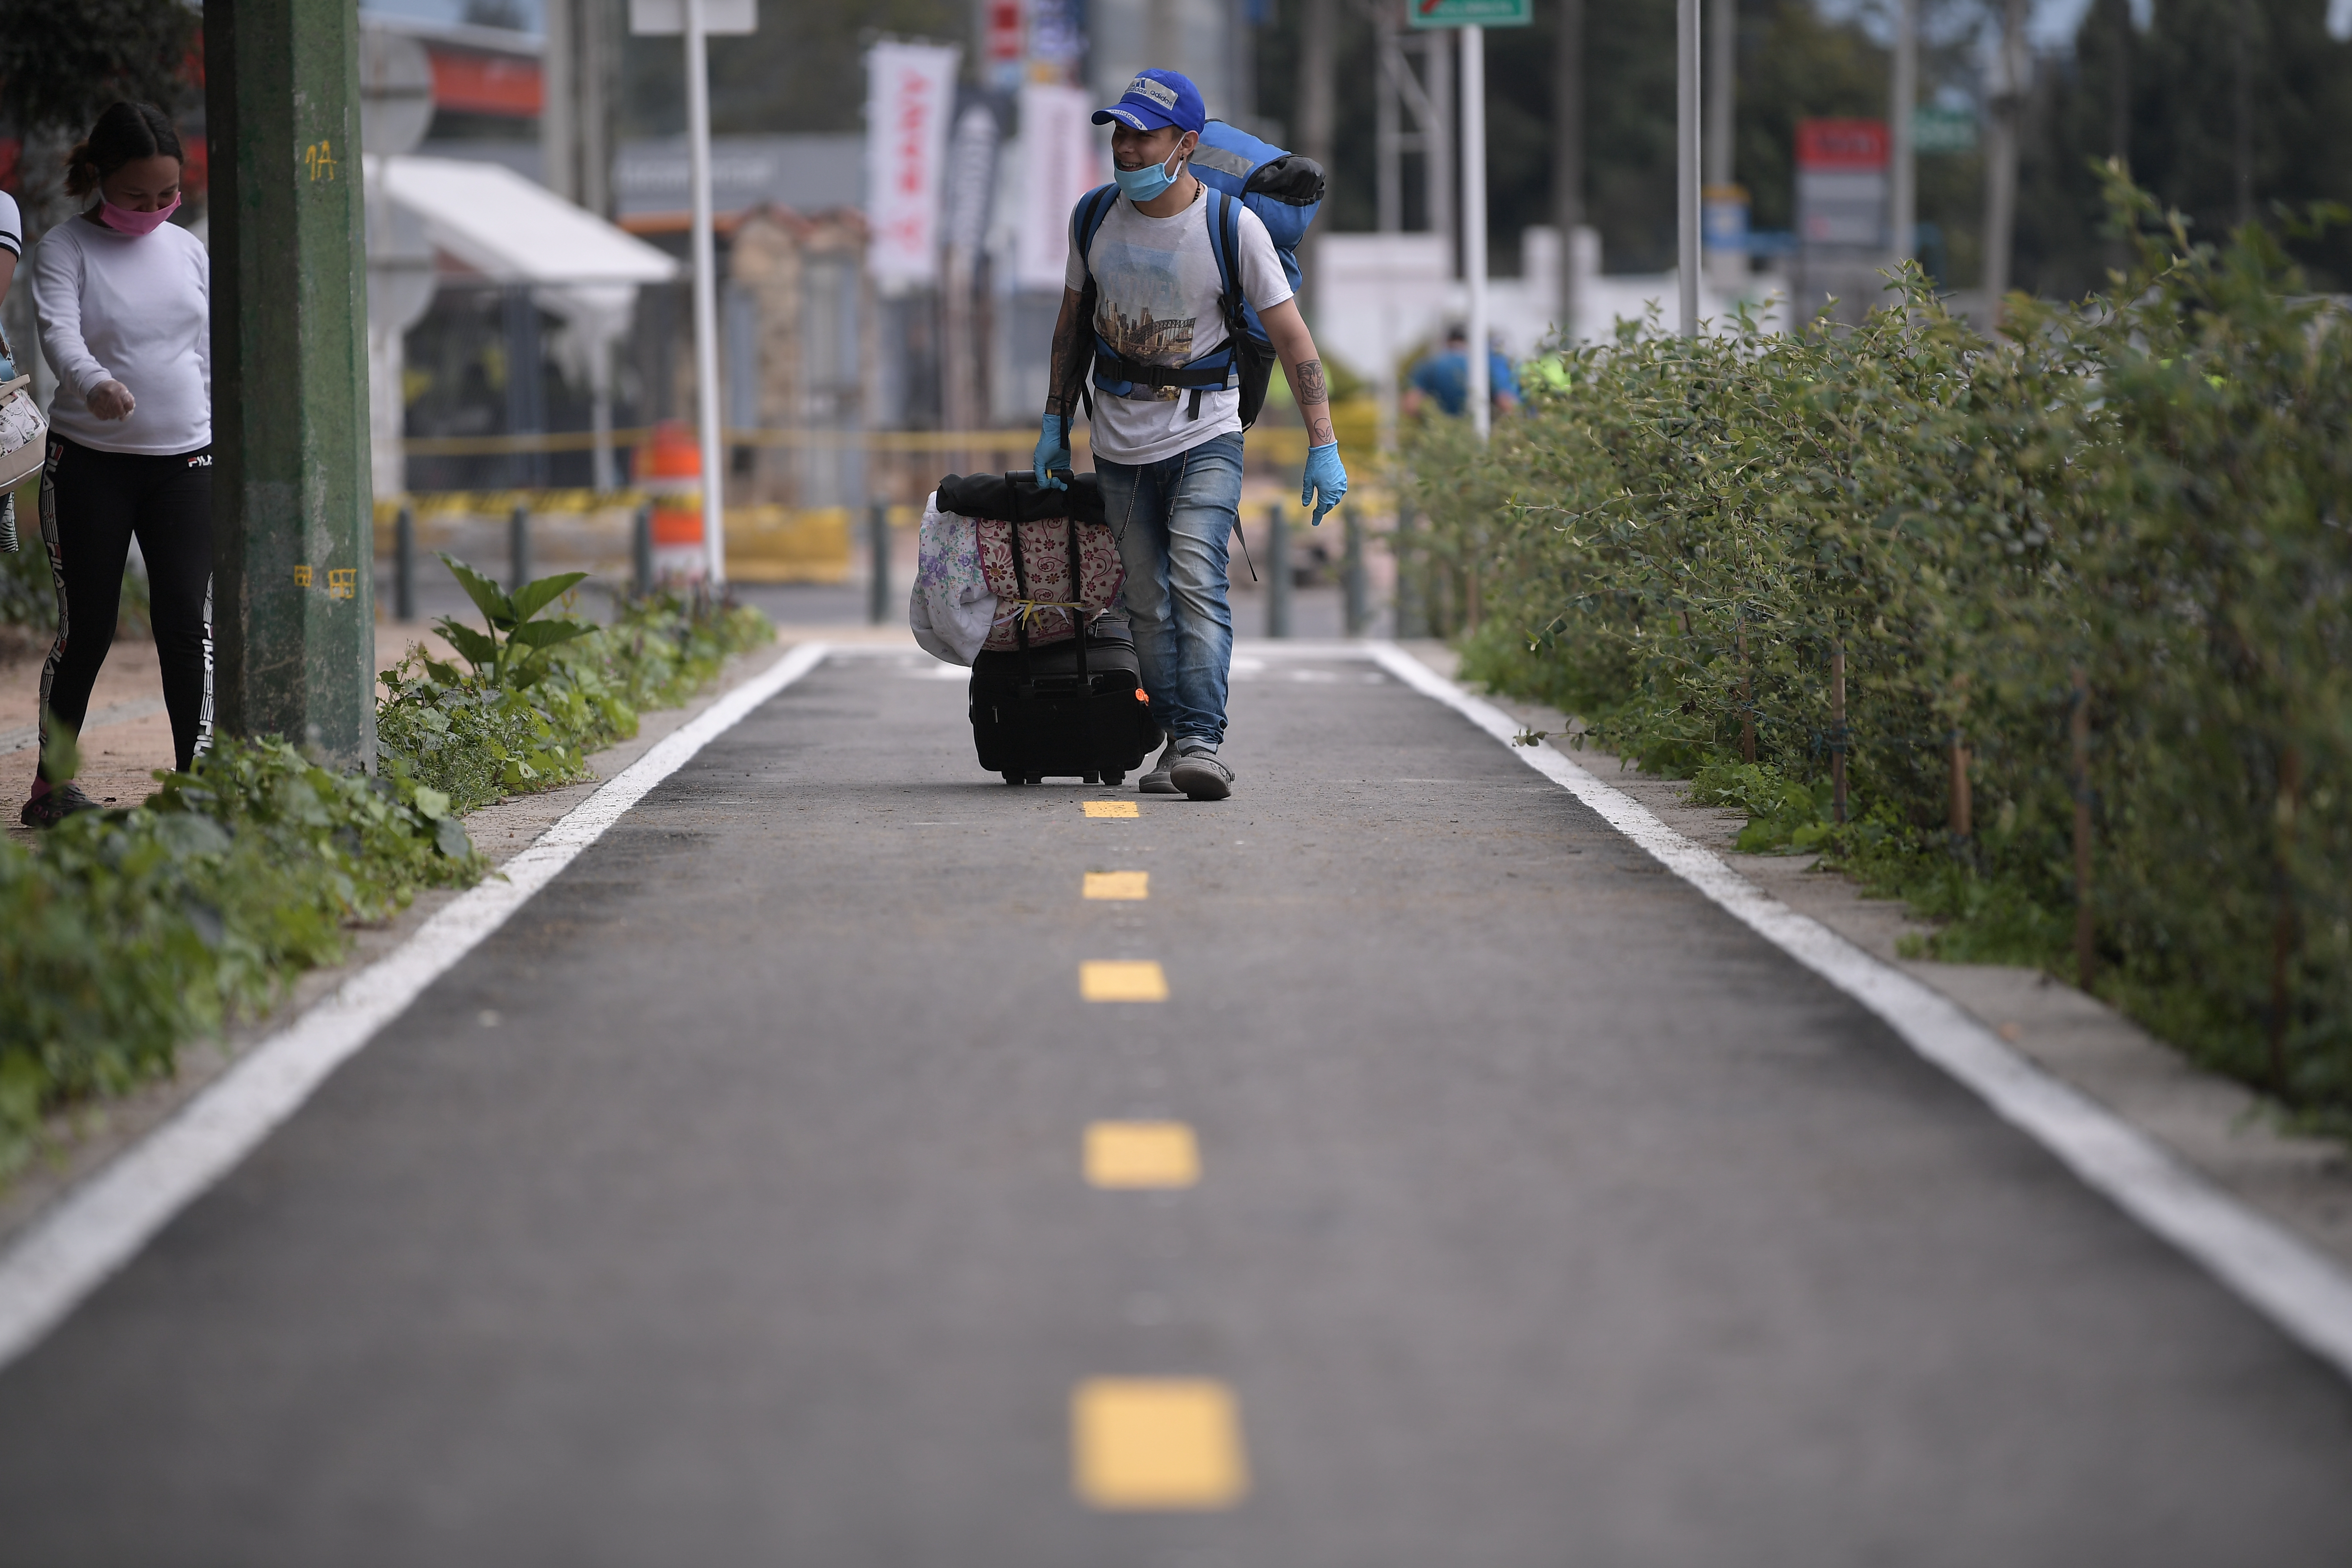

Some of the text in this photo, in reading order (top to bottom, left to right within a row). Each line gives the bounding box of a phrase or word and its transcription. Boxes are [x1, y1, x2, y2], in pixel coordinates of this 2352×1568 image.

[1111, 110, 1135, 122] adidas
[1150, 90, 1173, 106] adidas
[43, 441, 63, 491] FILA
[46, 542, 64, 588] FILA
[44, 634, 67, 675] FILA
